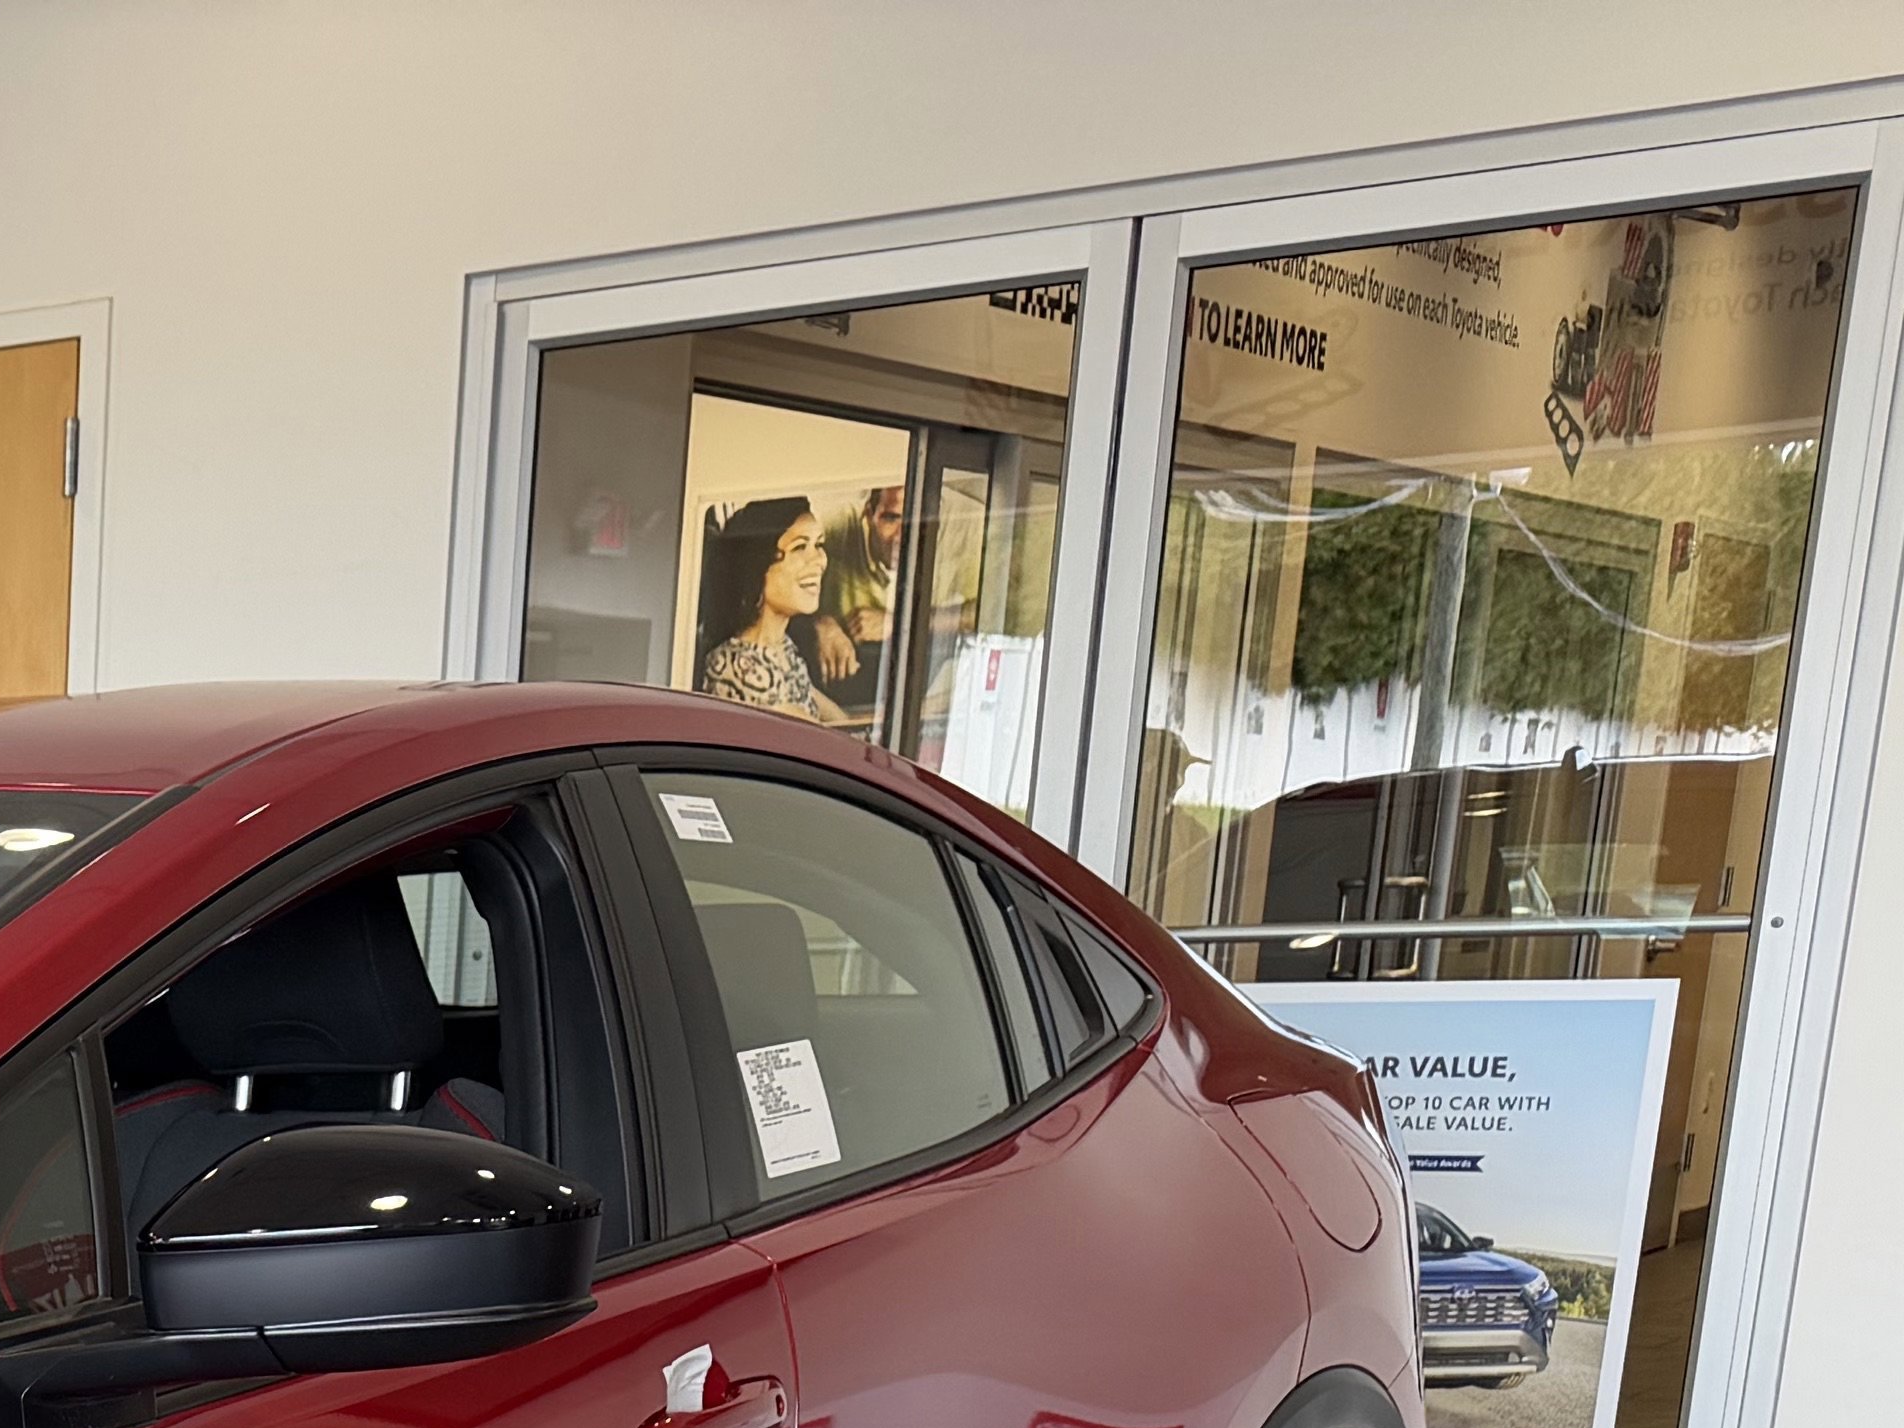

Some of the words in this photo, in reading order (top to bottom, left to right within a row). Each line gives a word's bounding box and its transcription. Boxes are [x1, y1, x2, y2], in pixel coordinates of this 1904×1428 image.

[1453, 237, 1502, 290] designed,
[1282, 255, 1308, 281] and
[1309, 258, 1368, 298] approved
[1367, 266, 1385, 305] for
[1385, 284, 1406, 313] use
[1406, 291, 1422, 318] on
[1423, 292, 1448, 326] each
[1450, 297, 1484, 340] Toyota
[1485, 309, 1520, 349] vehicle.
[1198, 297, 1221, 344] TO
[1223, 304, 1279, 362] LEARN
[1279, 321, 1328, 372] MORE
[1365, 1055, 1400, 1078] AR
[1410, 1055, 1517, 1083] VALUE,
[1385, 1096, 1417, 1111] OP
[1423, 1096, 1443, 1111] 10
[1449, 1095, 1490, 1111] CAR
[1497, 1095, 1551, 1112] WITH
[1444, 1116, 1514, 1132] VALUE.
